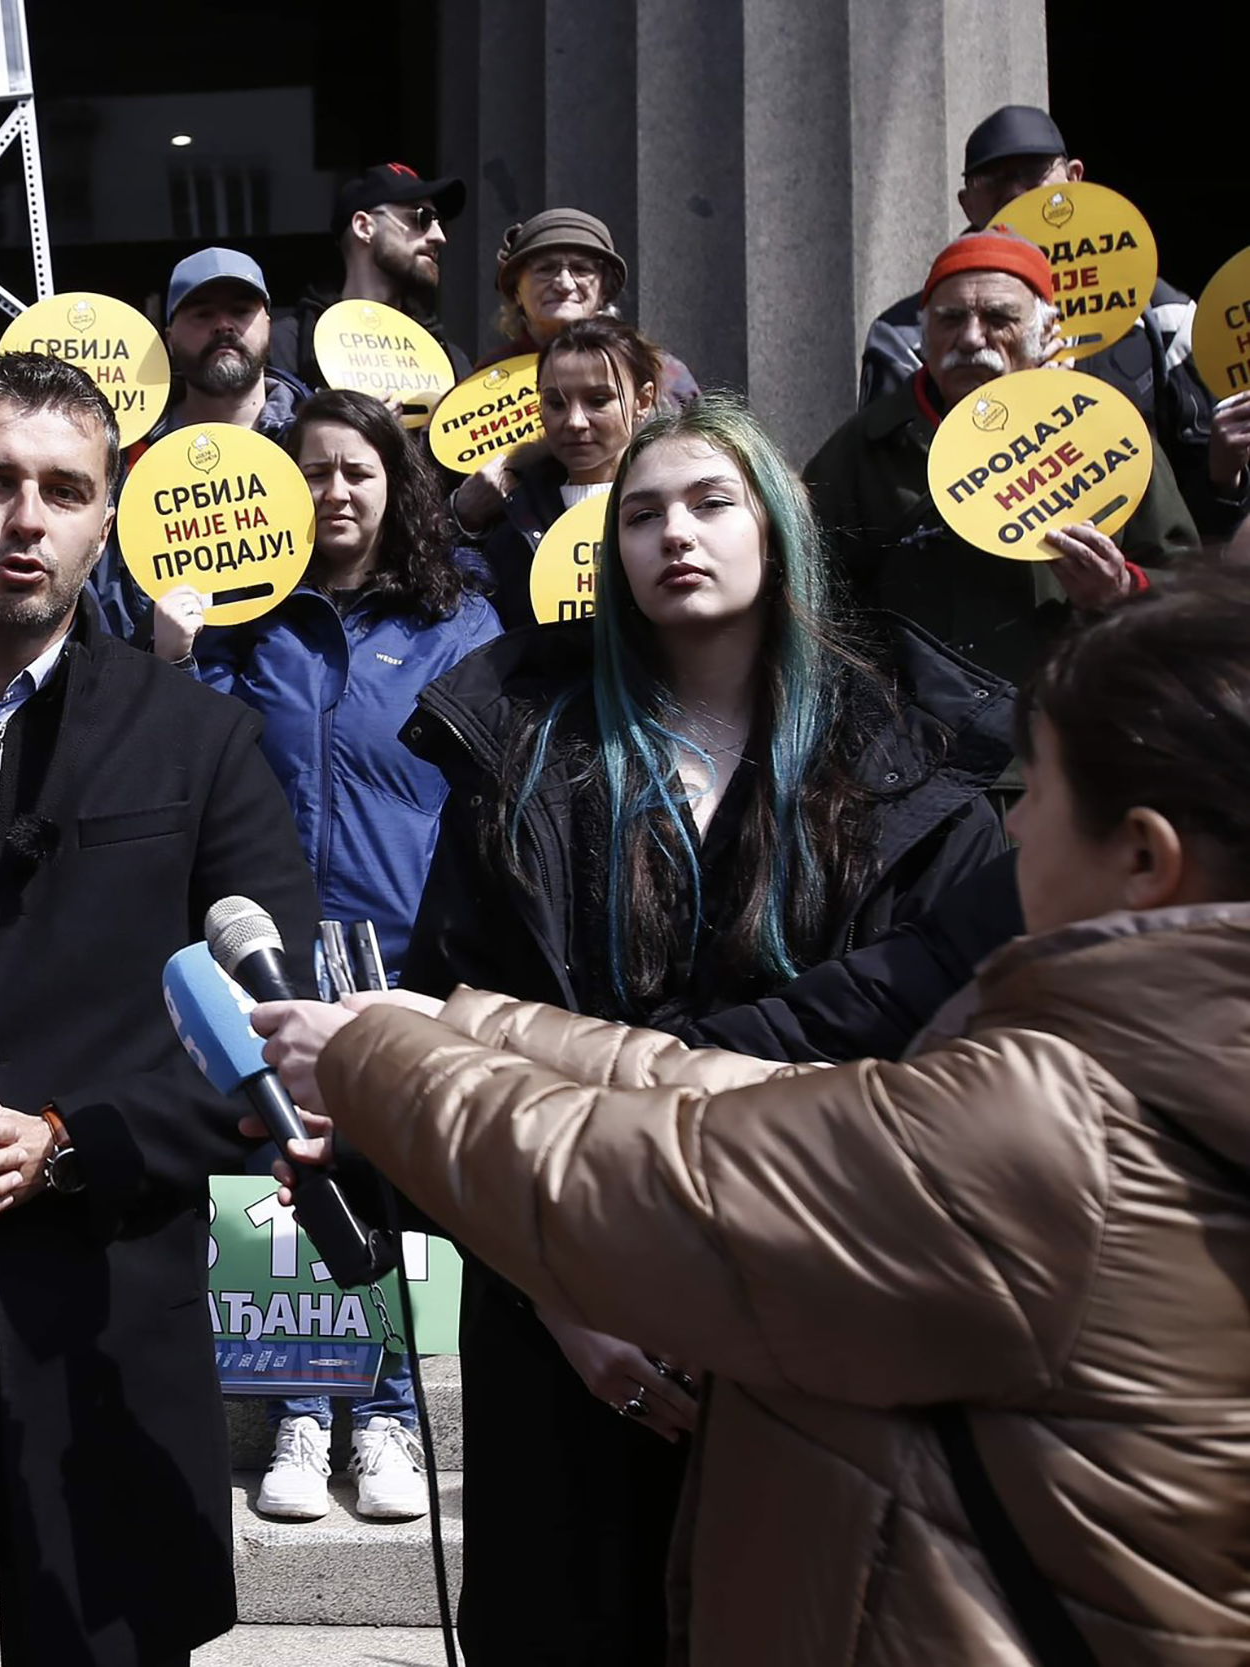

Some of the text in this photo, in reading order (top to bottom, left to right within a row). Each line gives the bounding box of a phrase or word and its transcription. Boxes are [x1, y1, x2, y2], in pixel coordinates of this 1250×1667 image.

[339, 332, 416, 351] СРБИЈА
[348, 353, 420, 369] НИЈЕ НА
[97, 366, 126, 384] НА
[340, 371, 440, 391] ПРОДАЈУ!
[442, 385, 537, 434] ПРОДА
[469, 400, 540, 441] НИЈЕ
[947, 393, 1099, 504] ПРОДАЈА
[154, 472, 268, 516] СРБИЈА
[993, 440, 1084, 511] НИЈЕ
[998, 437, 1140, 543] ОПЦИЈА!
[164, 506, 269, 544] НИЈЕ НА
[152, 530, 295, 580] ПРОДАЈУ!
